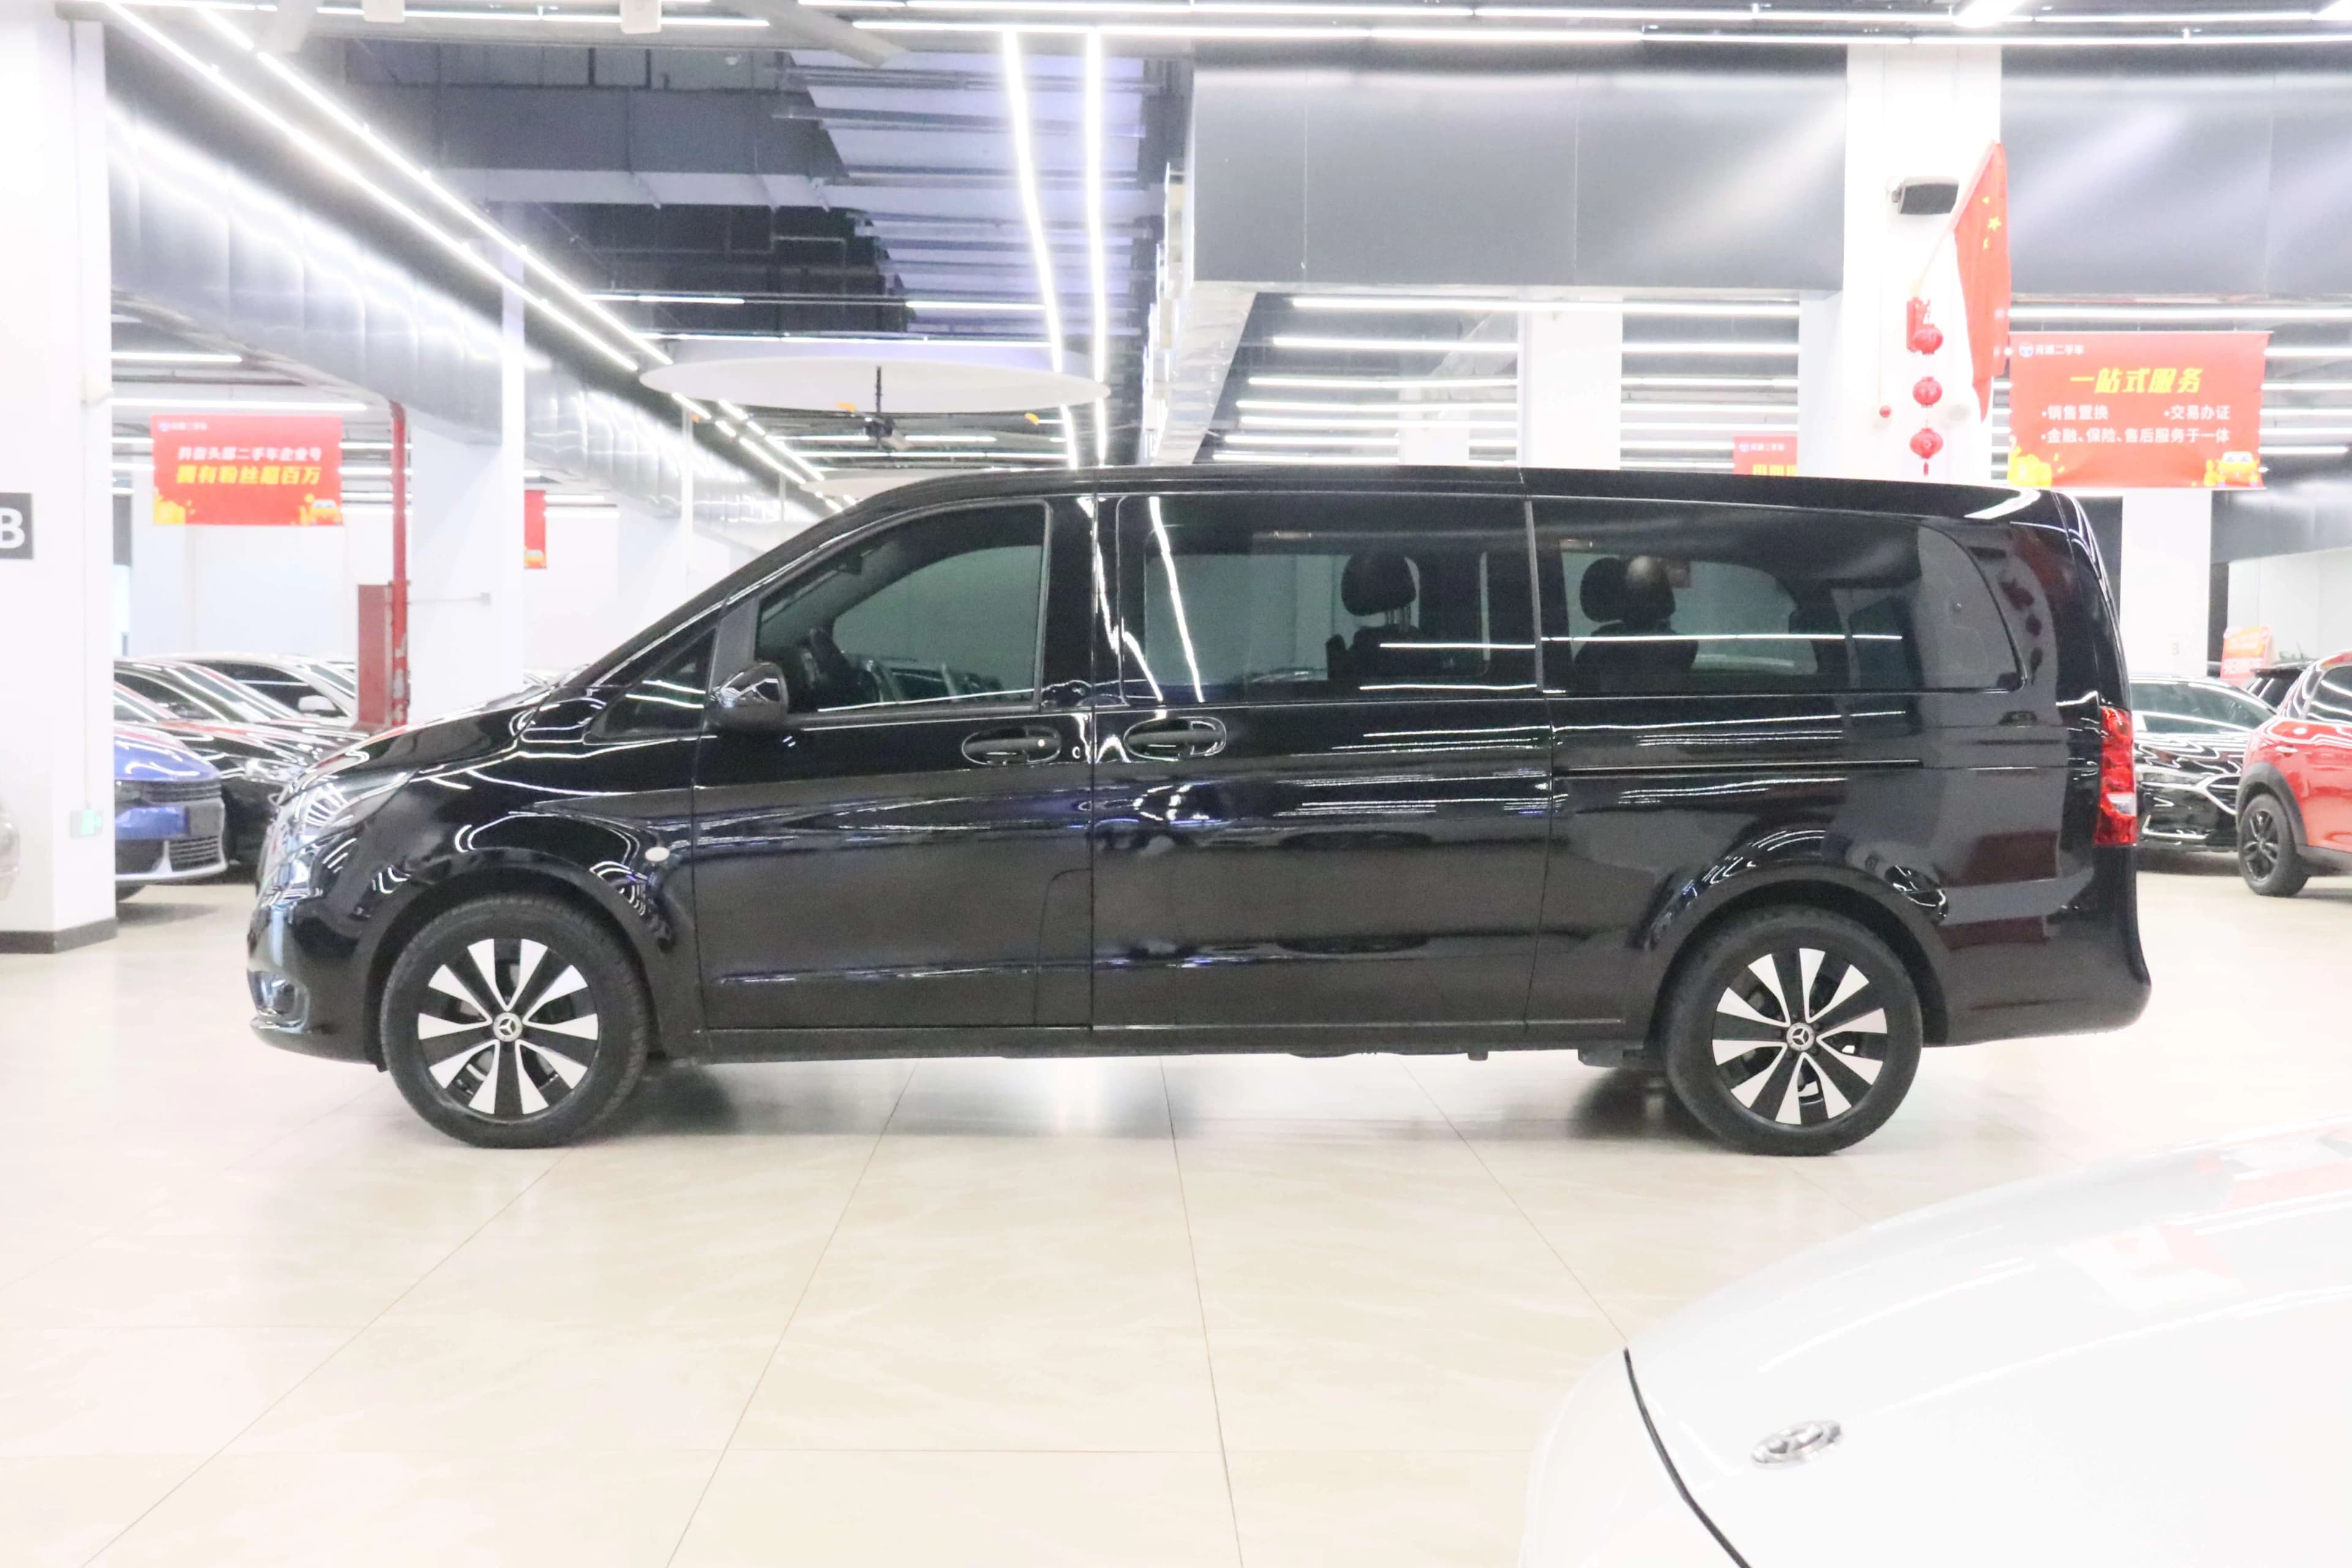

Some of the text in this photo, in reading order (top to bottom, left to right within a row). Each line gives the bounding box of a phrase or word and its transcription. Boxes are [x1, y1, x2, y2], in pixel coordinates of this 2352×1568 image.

[2070, 368, 2203, 393] 一站式服务
[2048, 405, 2109, 420] 销售置换
[2171, 405, 2231, 420] 交易办证
[0, 507, 25, 549] B
